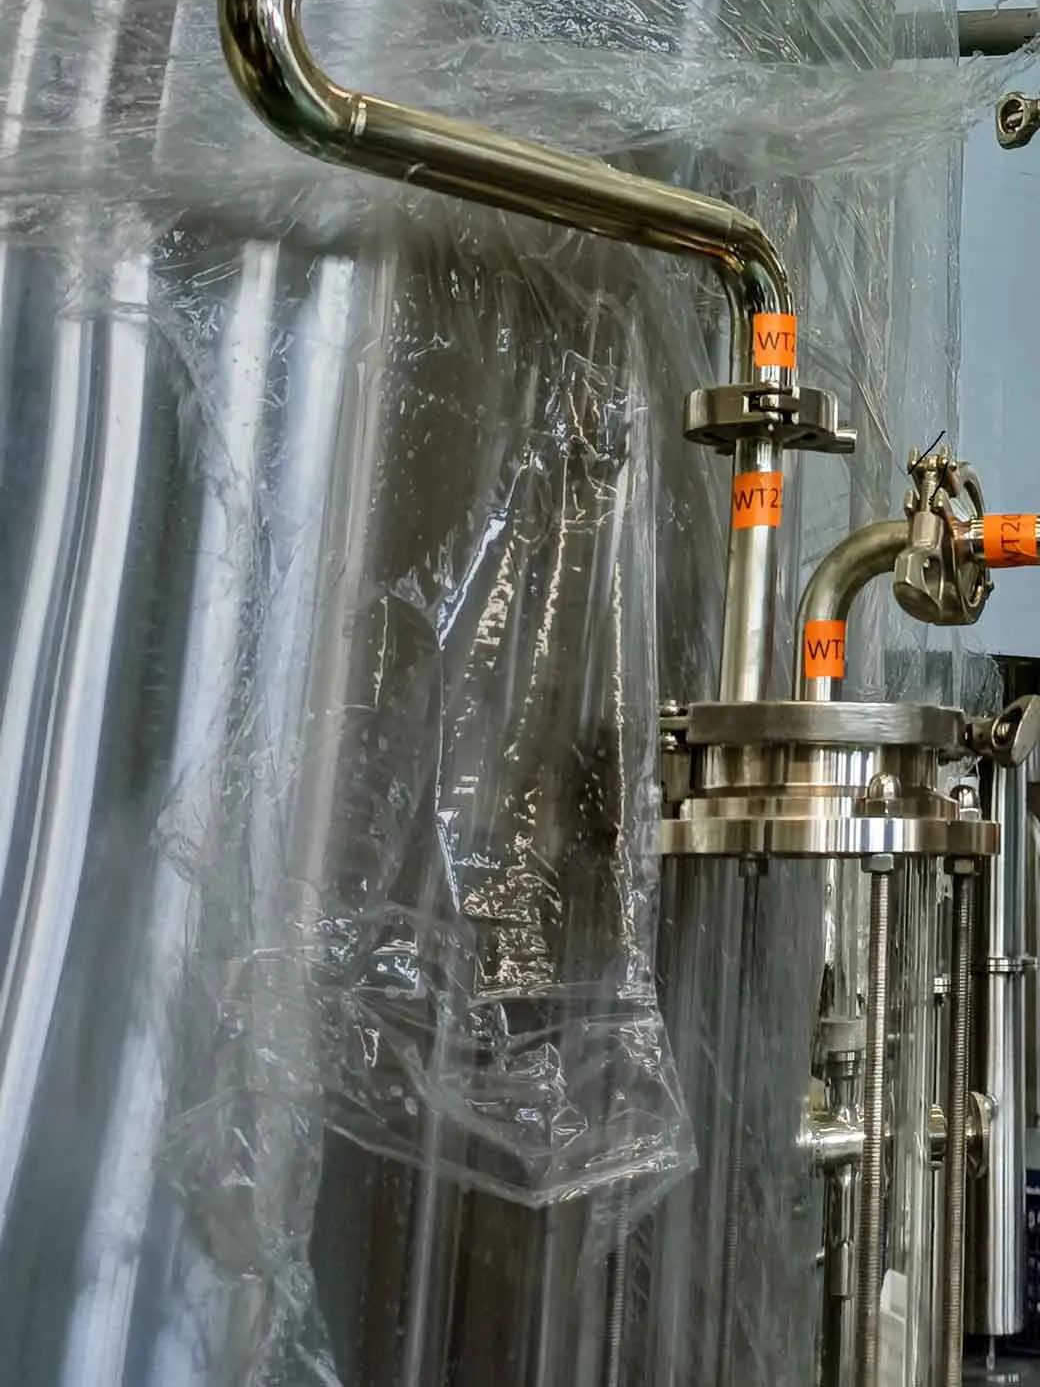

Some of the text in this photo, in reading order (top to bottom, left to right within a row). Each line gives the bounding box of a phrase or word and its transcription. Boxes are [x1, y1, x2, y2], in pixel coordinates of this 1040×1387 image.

[757, 331, 796, 353] WT
[735, 487, 784, 511] WT2
[808, 638, 845, 661] WT
